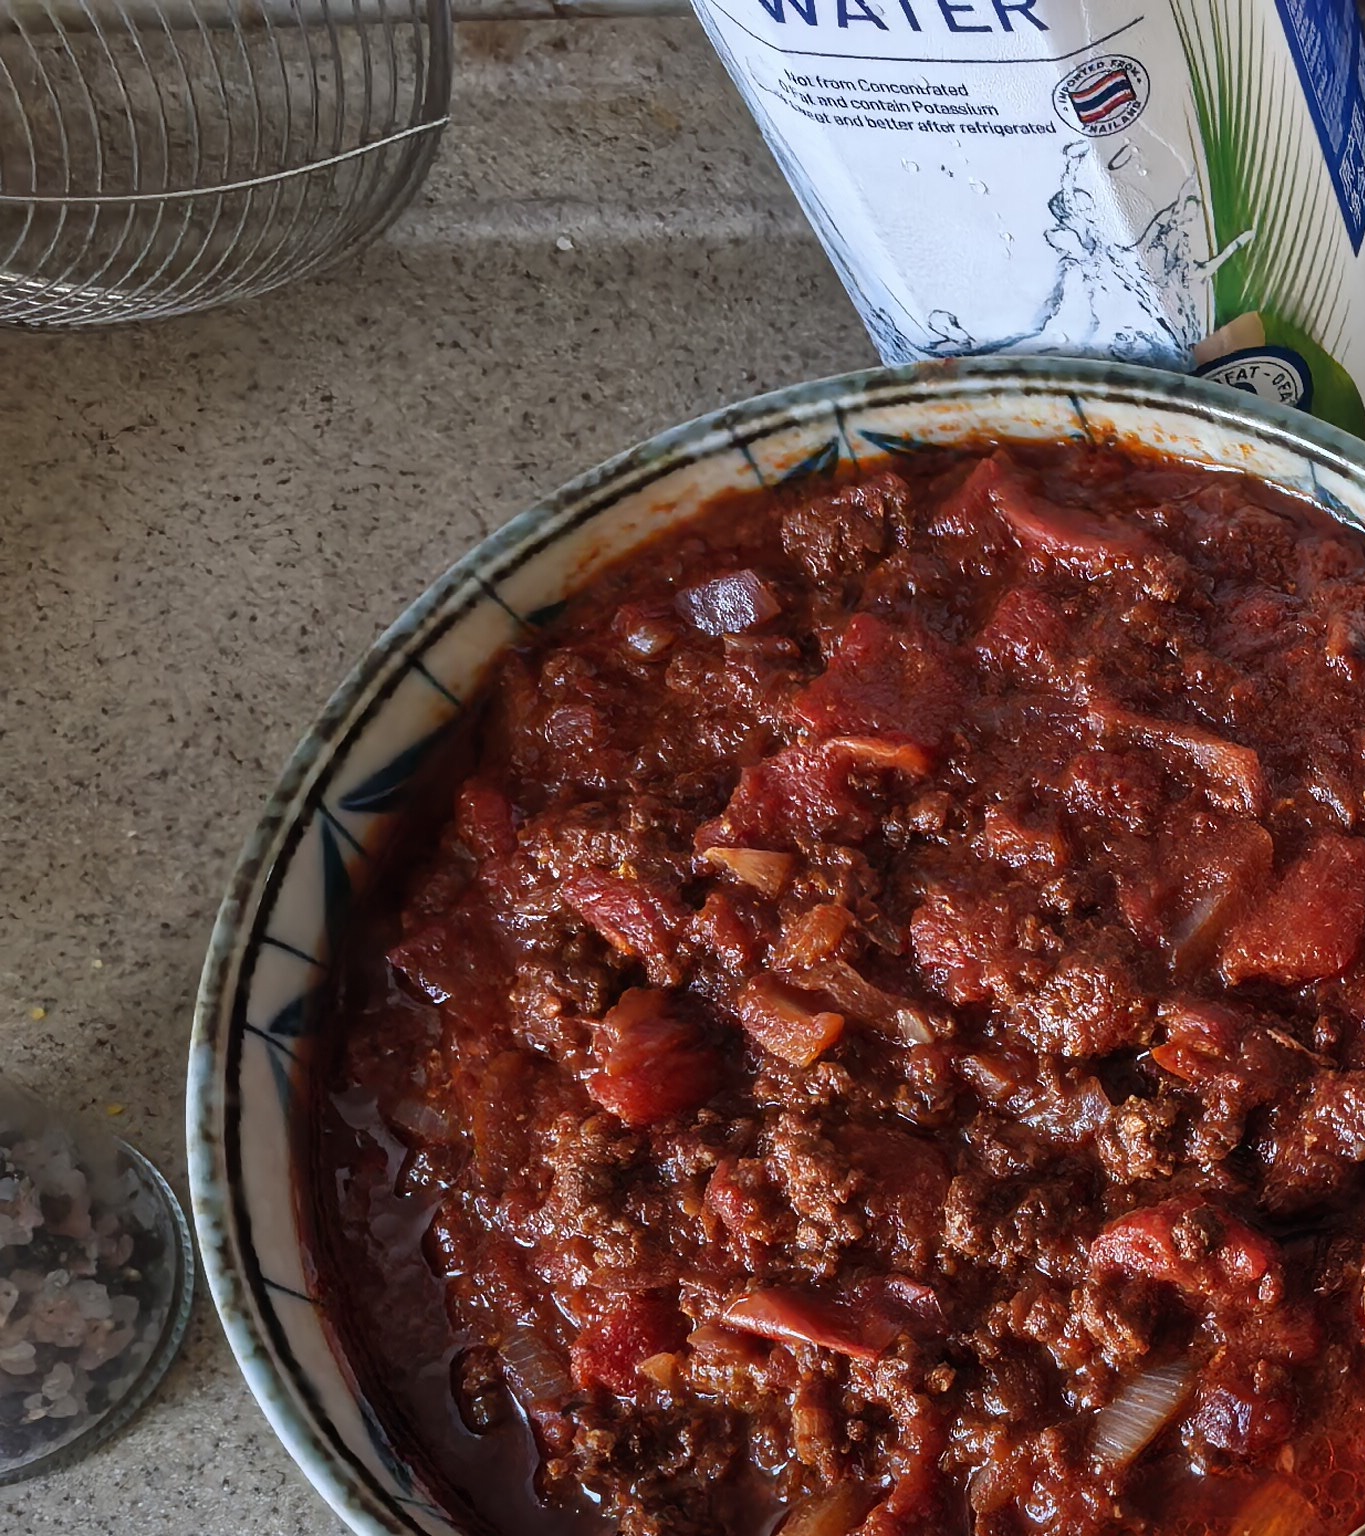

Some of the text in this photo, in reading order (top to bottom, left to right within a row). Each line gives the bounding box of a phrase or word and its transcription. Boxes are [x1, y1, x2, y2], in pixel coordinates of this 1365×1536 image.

[757, 0, 1052, 33] WATER
[784, 68, 968, 97] Not from Concentrated
[817, 95, 848, 108] and
[850, 98, 910, 113] contain
[913, 100, 999, 117] Potassium
[833, 114, 864, 127] and
[866, 115, 913, 131] better
[919, 119, 955, 133] after
[960, 120, 1057, 137] refrigerated
